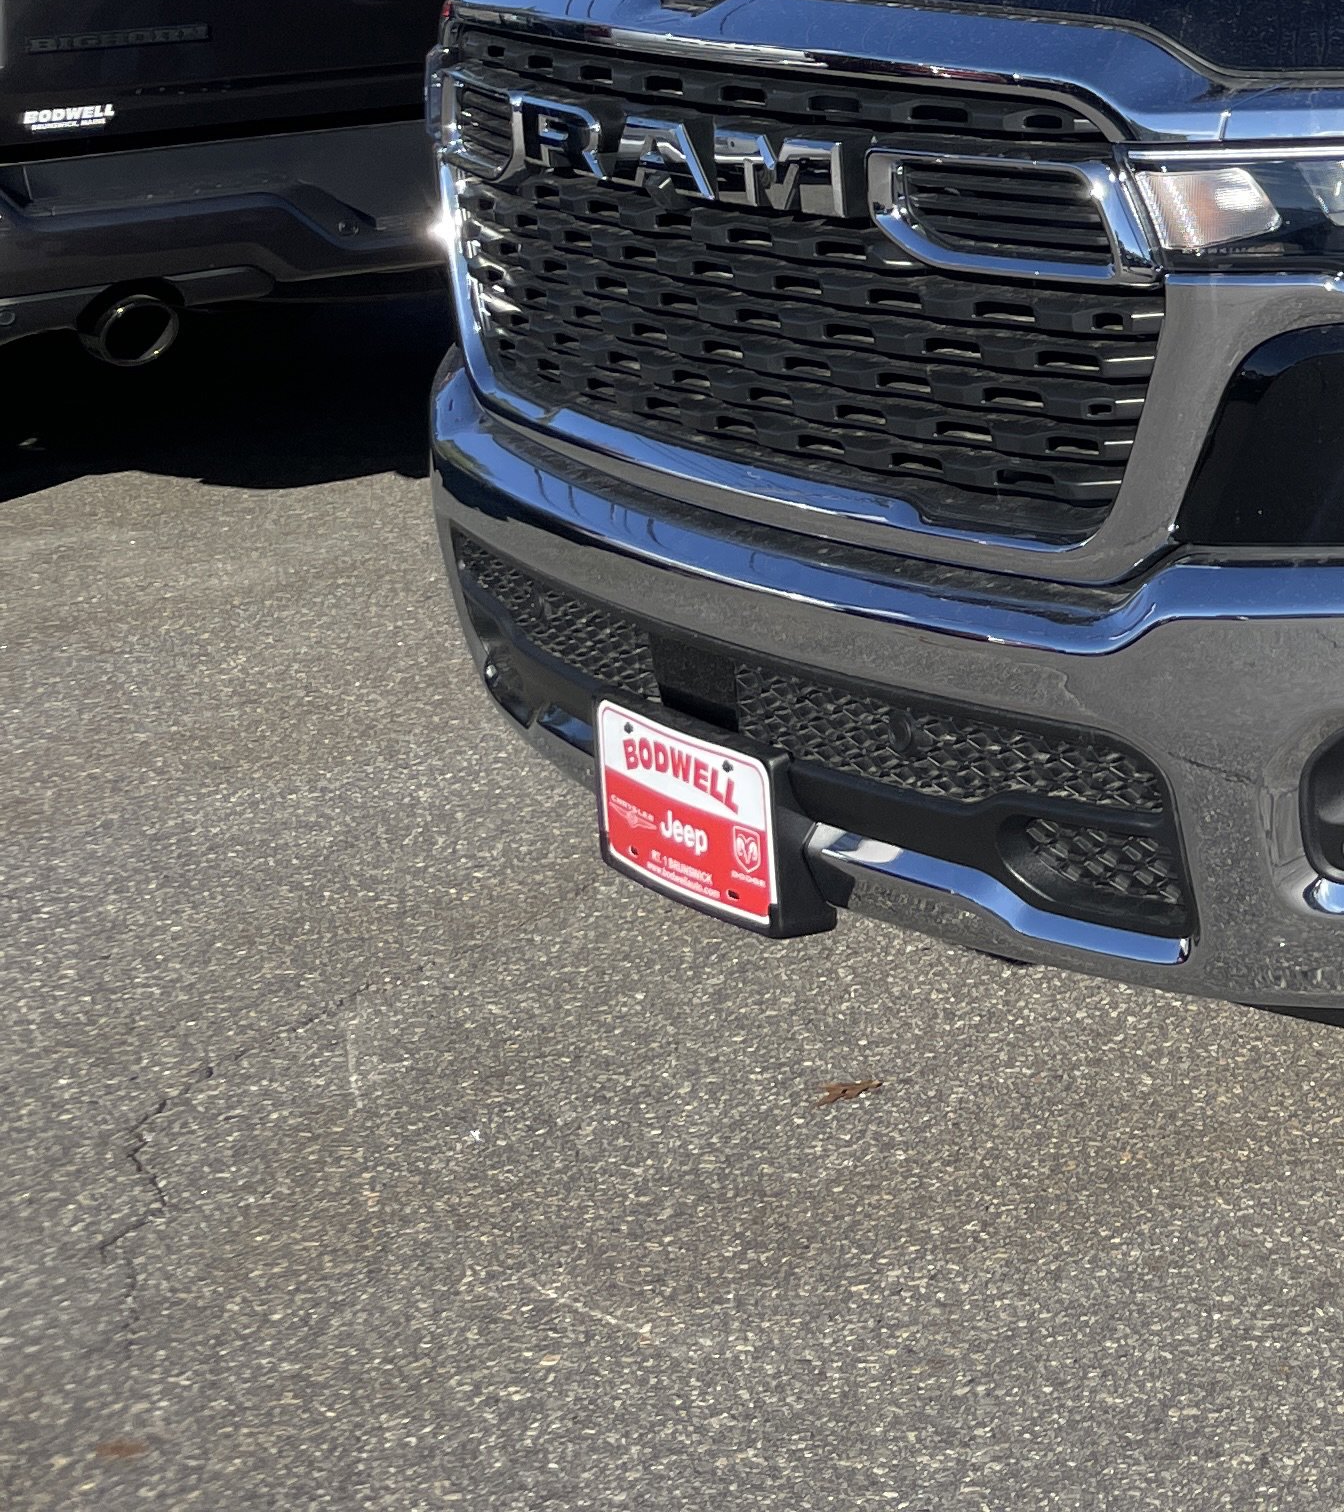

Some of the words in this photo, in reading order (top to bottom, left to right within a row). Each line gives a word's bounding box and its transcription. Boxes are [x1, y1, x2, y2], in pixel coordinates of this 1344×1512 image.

[23, 103, 115, 125] BODWELL
[510, 91, 849, 218] RAM
[622, 737, 739, 815] BODWELL
[610, 793, 654, 822] CHRYSLER
[659, 810, 708, 856] Jeep
[668, 857, 713, 887] BRUNSWICK
[731, 870, 766, 888] DODGE
